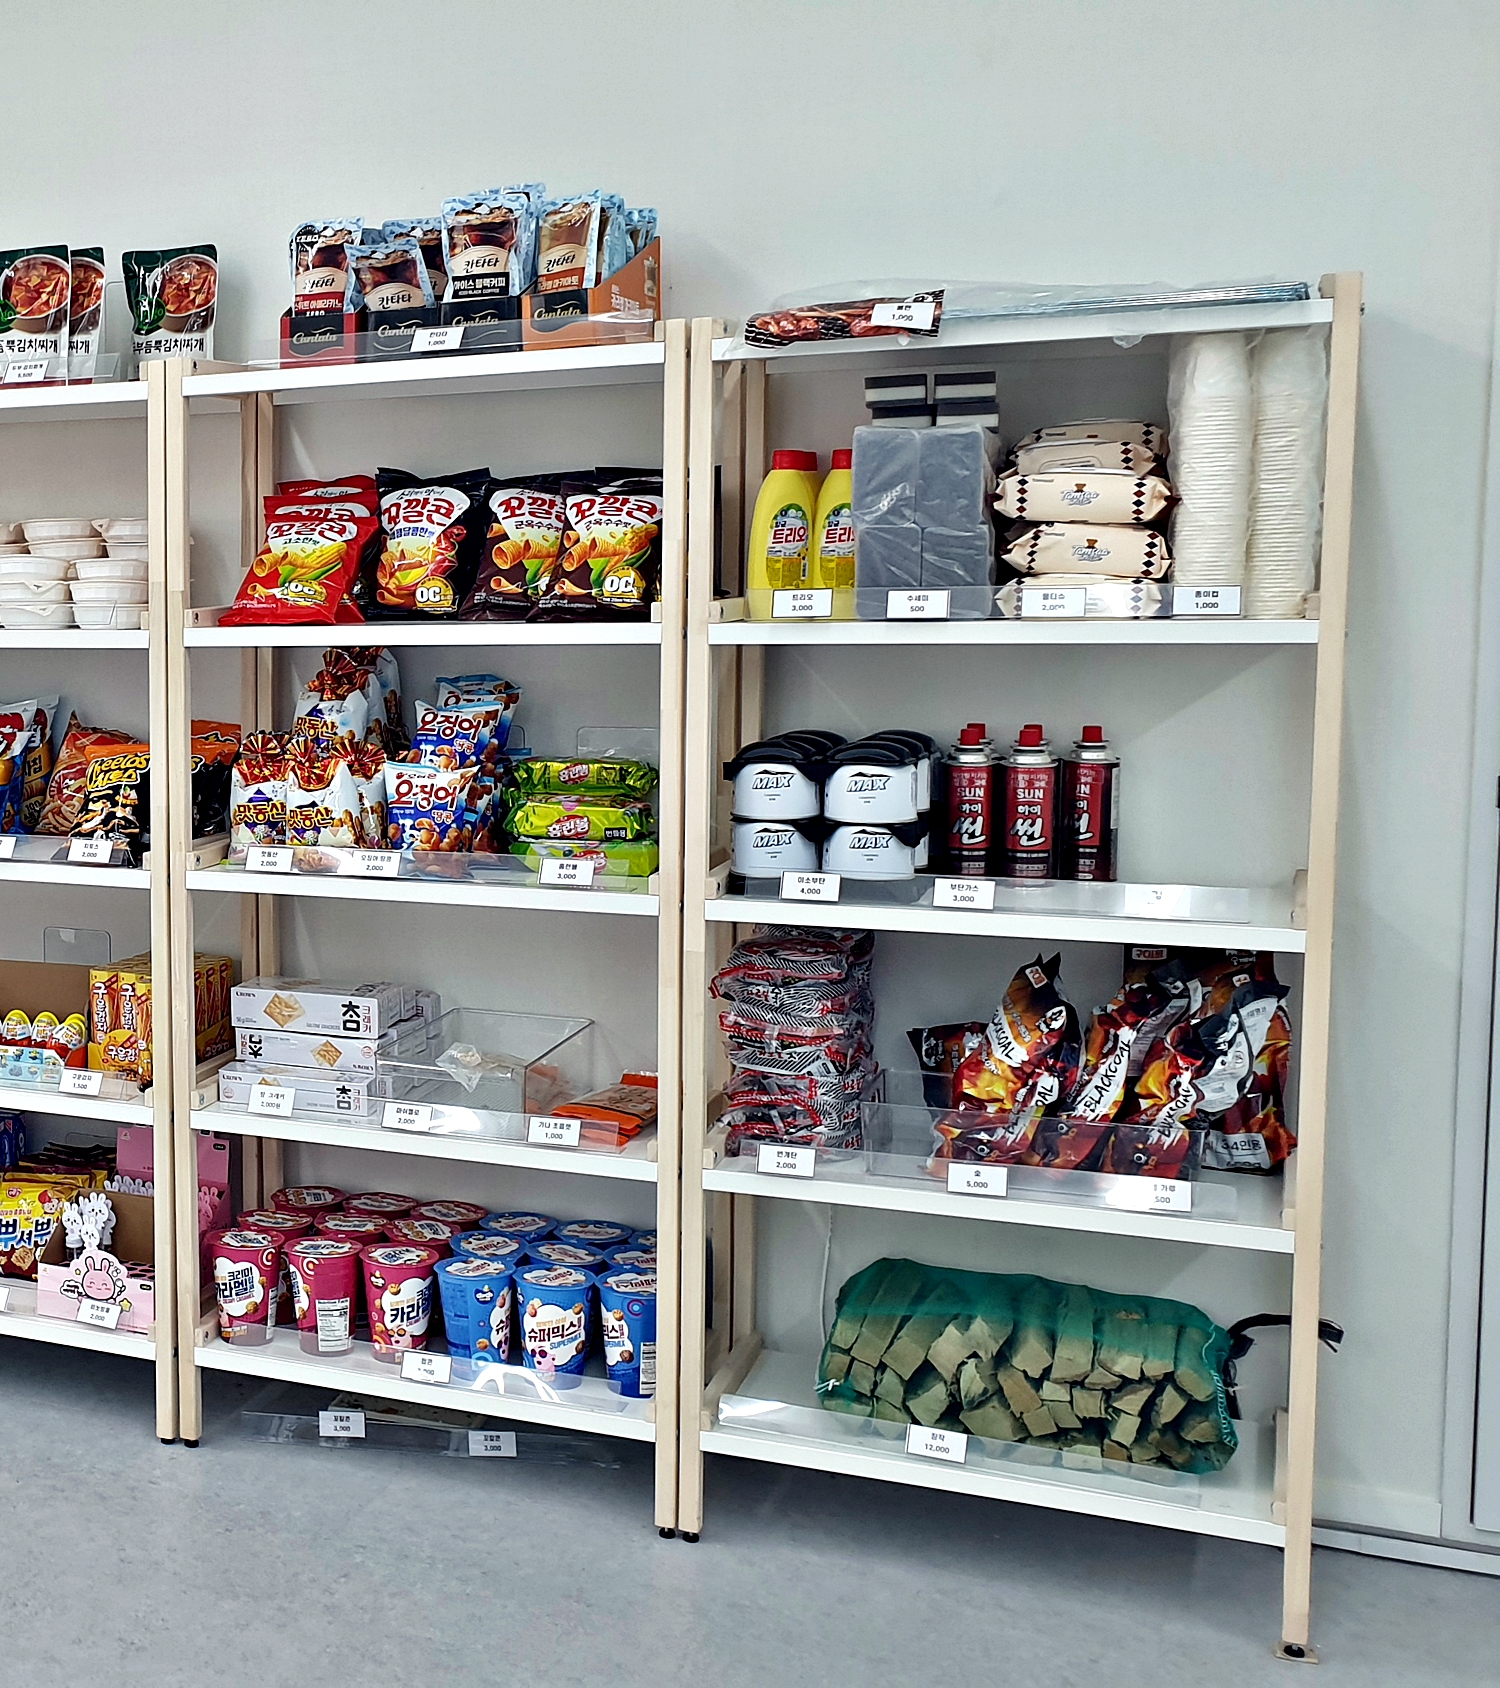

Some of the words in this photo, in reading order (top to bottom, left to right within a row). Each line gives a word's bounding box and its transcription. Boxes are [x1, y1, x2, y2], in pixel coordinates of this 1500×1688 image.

[464, 254, 500, 274] 칸타타
[545, 252, 576, 273] 칸타타
[453, 280, 475, 291] 아이스
[475, 276, 506, 289] 블랙커피
[378, 291, 413, 310] 칸타타
[534, 306, 582, 321] Cantata
[891, 313, 914, 322] 1,000
[381, 496, 460, 532] 꼬깔콘
[569, 494, 659, 525] 꼬깔콘
[269, 520, 346, 542] 꼬깔콘
[771, 526, 808, 546] 트리오
[289, 581, 316, 595] OC
[604, 576, 635, 593] OC
[415, 586, 442, 603] OC
[791, 593, 814, 602] 트리오
[906, 594, 930, 603] 수세미
[791, 604, 814, 612] 3,000
[909, 605, 925, 613] 500
[1194, 601, 1220, 610] 1,000
[296, 716, 339, 739] 맛동산
[417, 710, 485, 741] 오징어
[752, 773, 795, 790] MAX
[845, 776, 891, 793] MAX
[389, 780, 459, 811] 오징어
[956, 787, 985, 798] SUN
[1016, 788, 1044, 799] SUN
[236, 801, 287, 824] 맛동산
[1017, 804, 1041, 816] 하이
[288, 806, 333, 830] 맛동산
[1010, 817, 1046, 846] 썬
[752, 832, 796, 848] MAX
[849, 834, 894, 850] MAX
[797, 876, 826, 885] 이소부탄
[950, 883, 979, 892] 부탄가스
[800, 887, 821, 895] 4,000
[952, 895, 975, 903] 3,000
[235, 990, 256, 998] CROWN
[340, 1000, 361, 1033] 참
[1083, 1039, 1132, 1114] BLACKCOAL
[72, 1082, 88, 1090] 1,500
[335, 1085, 352, 1110] 참
[397, 1117, 416, 1125] 2,000
[538, 1121, 551, 1129] 가나
[545, 1132, 564, 1140] 1,000
[776, 1151, 797, 1159] 번개탄
[776, 1161, 797, 1169] 2,000
[966, 1180, 989, 1188] 5,000
[1155, 1196, 1171, 1204] 500
[227, 1266, 253, 1281] 크리미
[89, 1313, 106, 1322] 2,000
[527, 1320, 579, 1343] 슈퍼믹스
[549, 1333, 582, 1351] SUPERMIX
[930, 1432, 946, 1442] 장작
[483, 1444, 502, 1452] 3,000
[924, 1443, 950, 1454] 12,000
